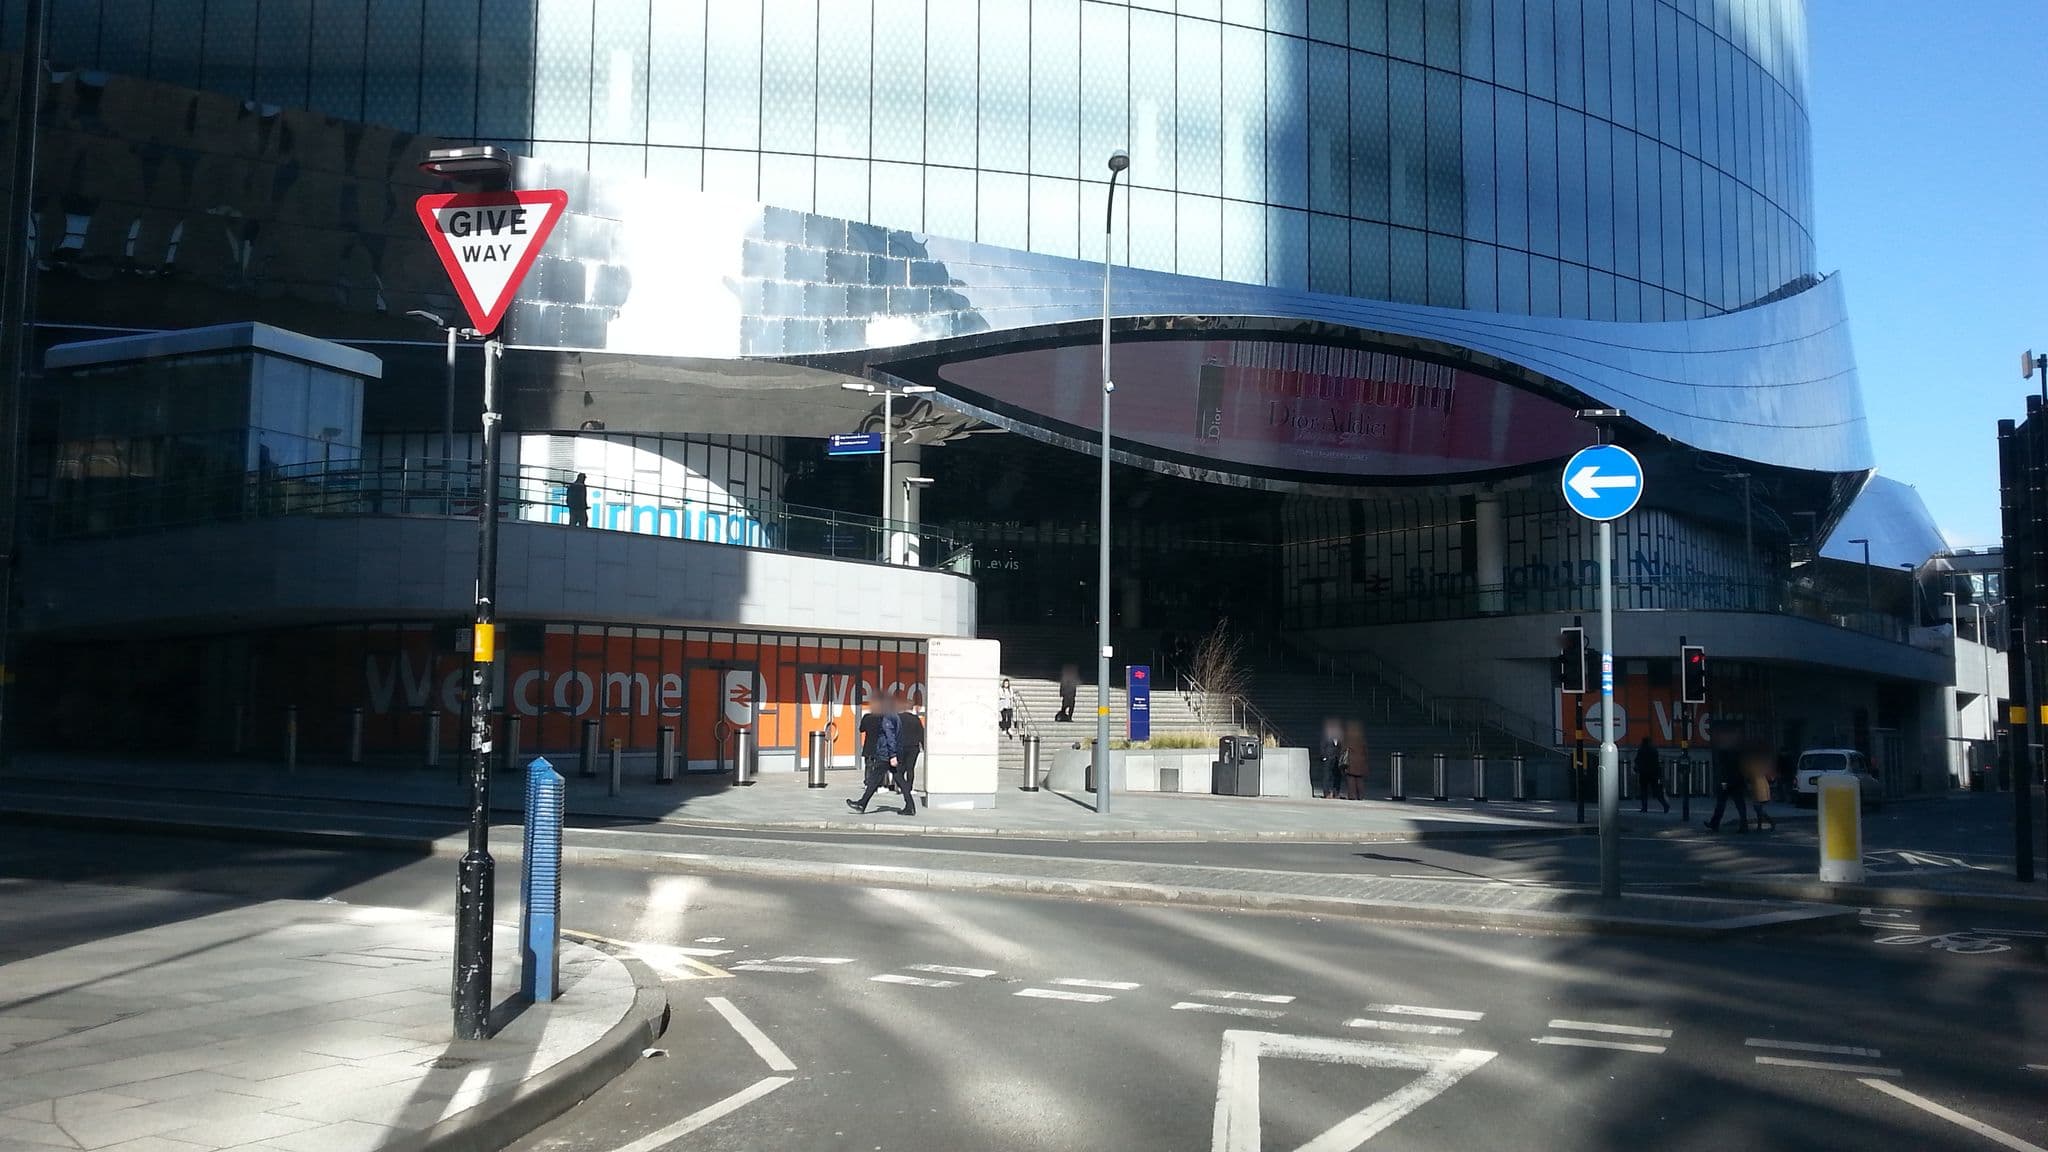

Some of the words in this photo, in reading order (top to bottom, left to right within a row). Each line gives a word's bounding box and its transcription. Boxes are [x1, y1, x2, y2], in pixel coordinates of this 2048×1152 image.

[449, 208, 527, 238] GIVE
[462, 244, 513, 262] WAY
[1208, 407, 1222, 441] Dior
[365, 648, 683, 717] Welcome
